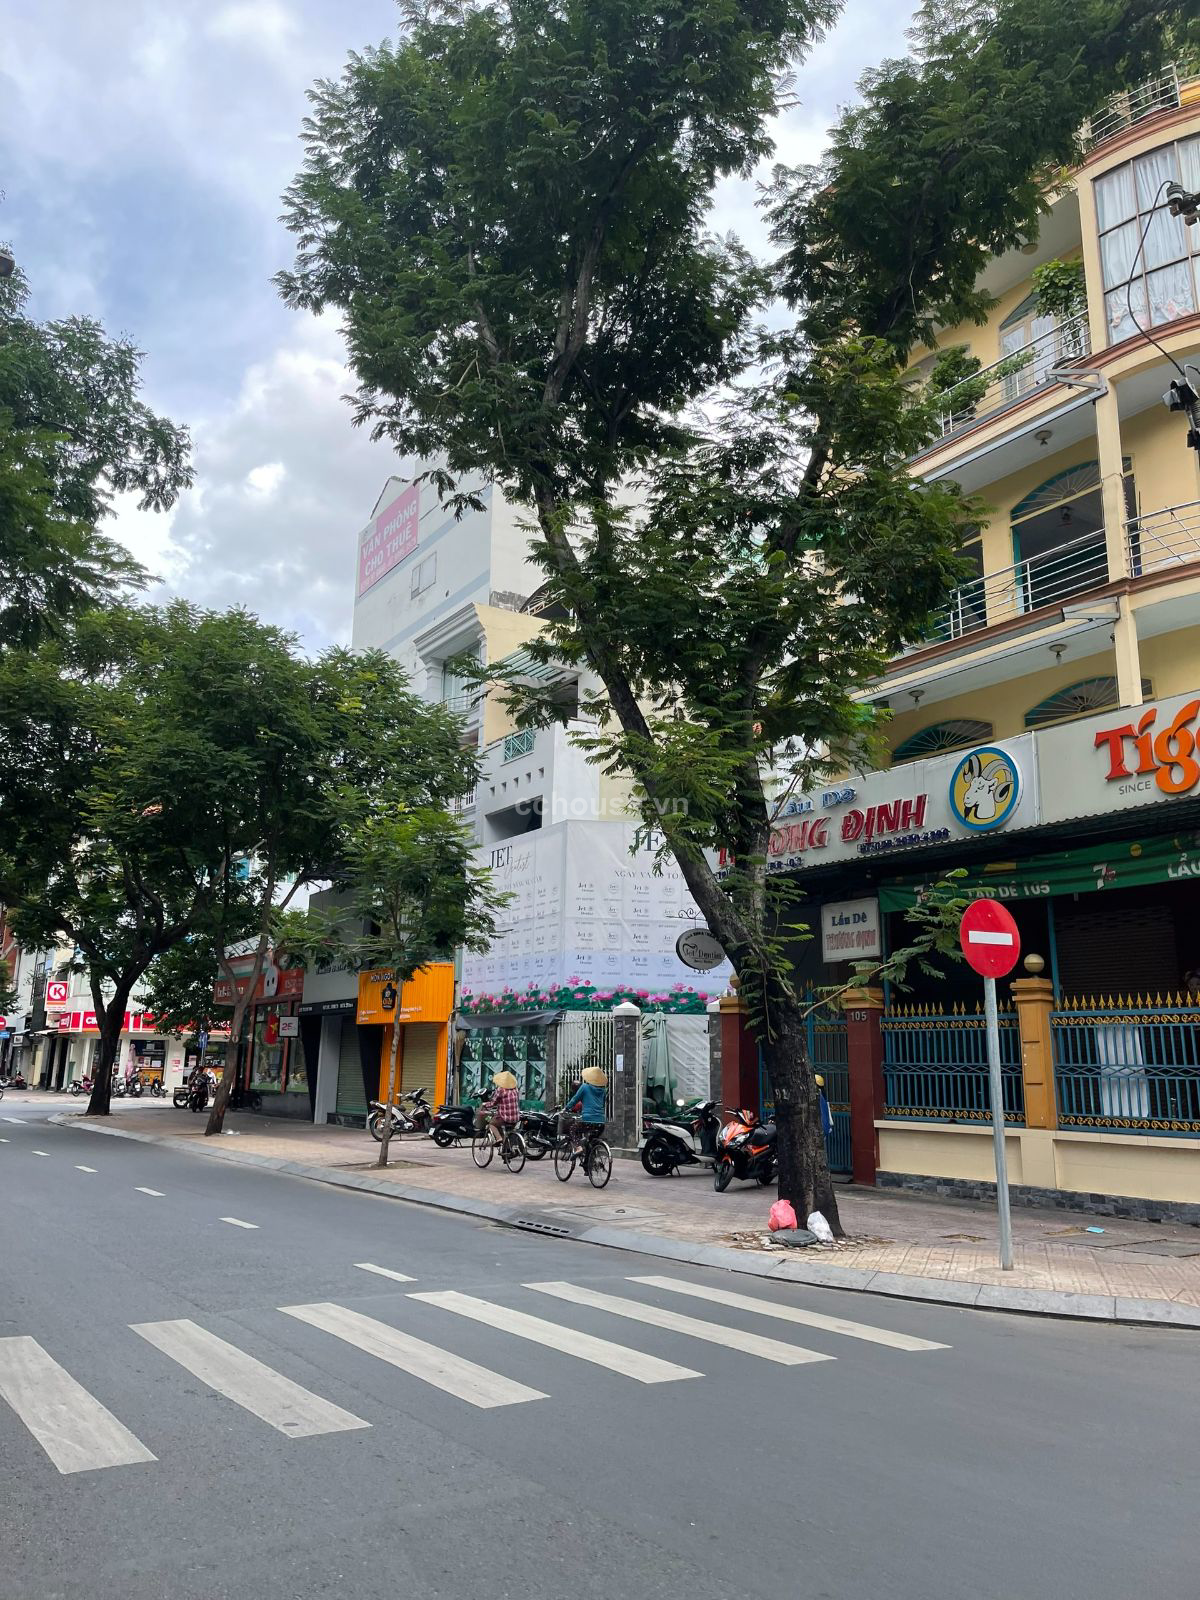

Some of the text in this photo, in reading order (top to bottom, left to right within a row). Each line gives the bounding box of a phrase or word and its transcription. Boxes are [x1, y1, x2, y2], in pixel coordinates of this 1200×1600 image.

[365, 550, 384, 576] CHO
[1094, 699, 1200, 794] Tig
[1118, 780, 1152, 795] SINCE
[841, 794, 928, 842] ĐỊNH
[489, 846, 513, 869] JET
[999, 880, 1018, 898] DÊ
[1023, 880, 1050, 896] 105
[53, 987, 63, 996] K
[850, 1010, 867, 1022] 105
